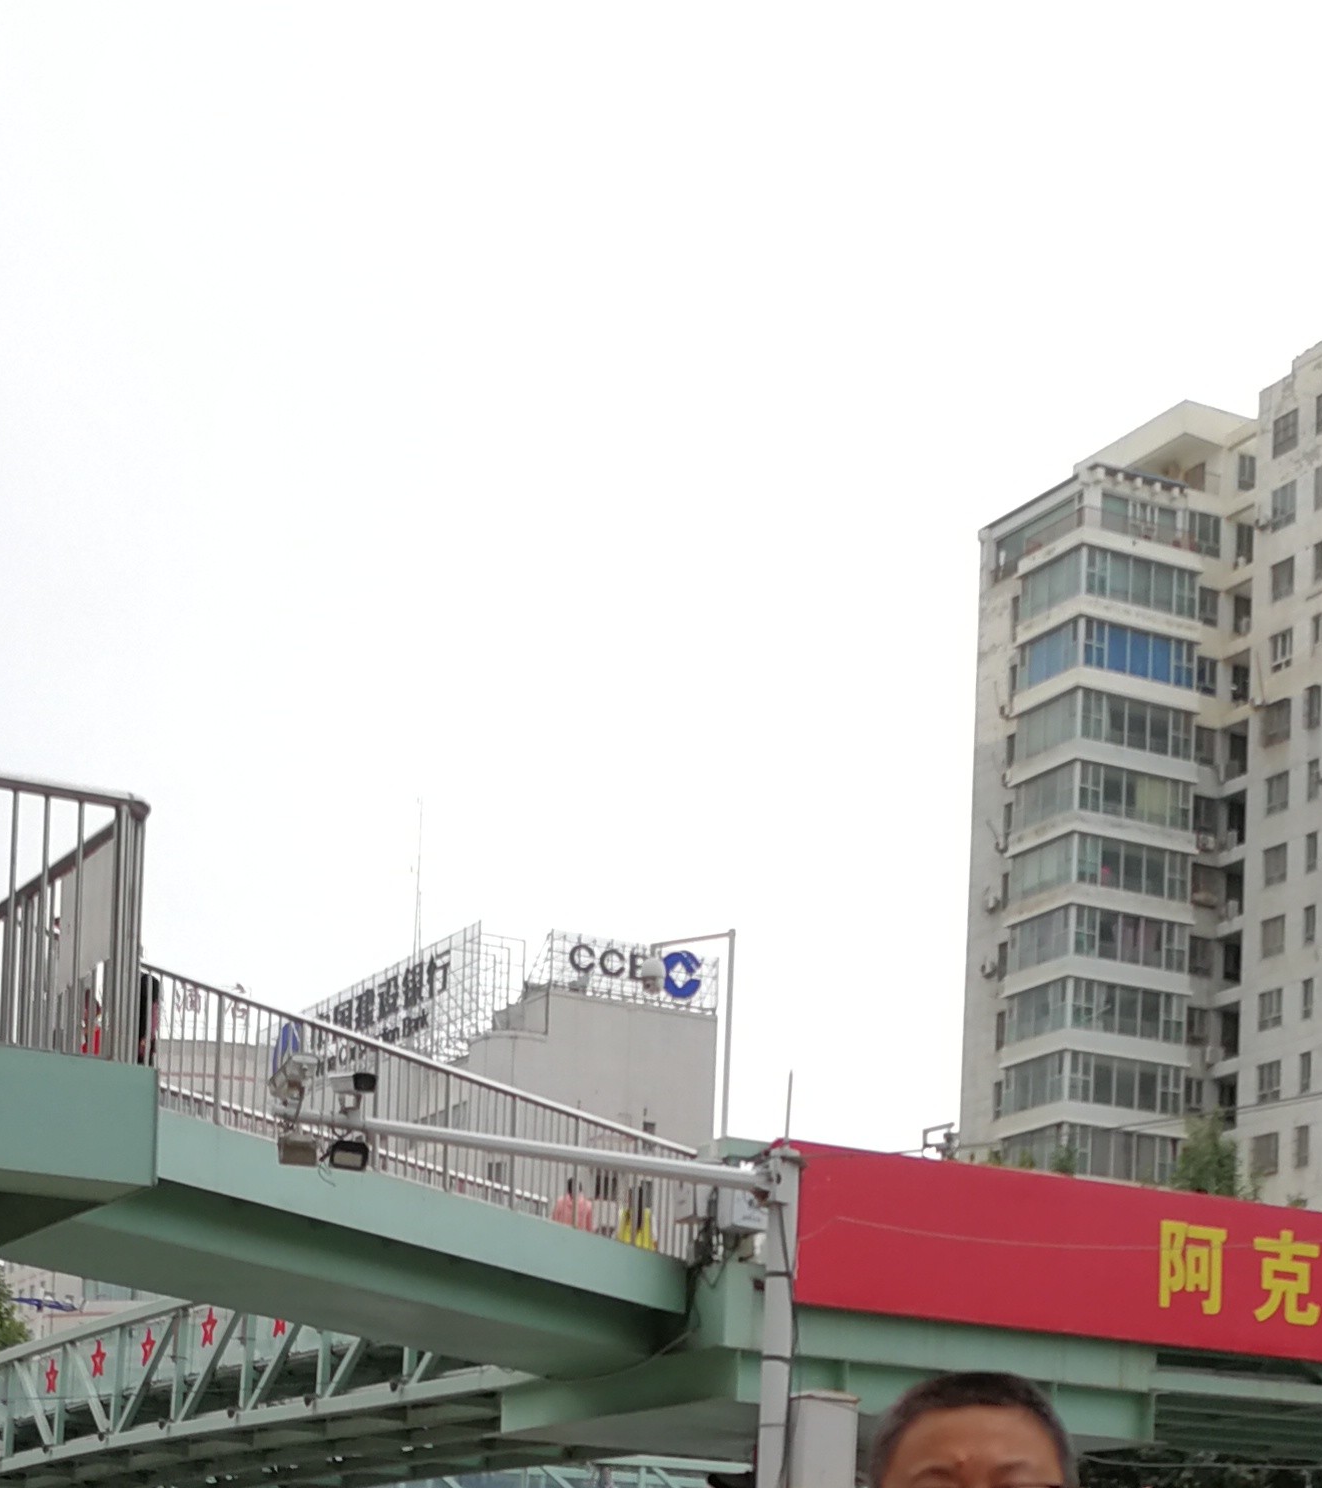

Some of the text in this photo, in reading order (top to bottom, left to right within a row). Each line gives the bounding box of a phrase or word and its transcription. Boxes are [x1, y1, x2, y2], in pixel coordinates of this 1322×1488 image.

[317, 949, 451, 1031] 国建设银行
